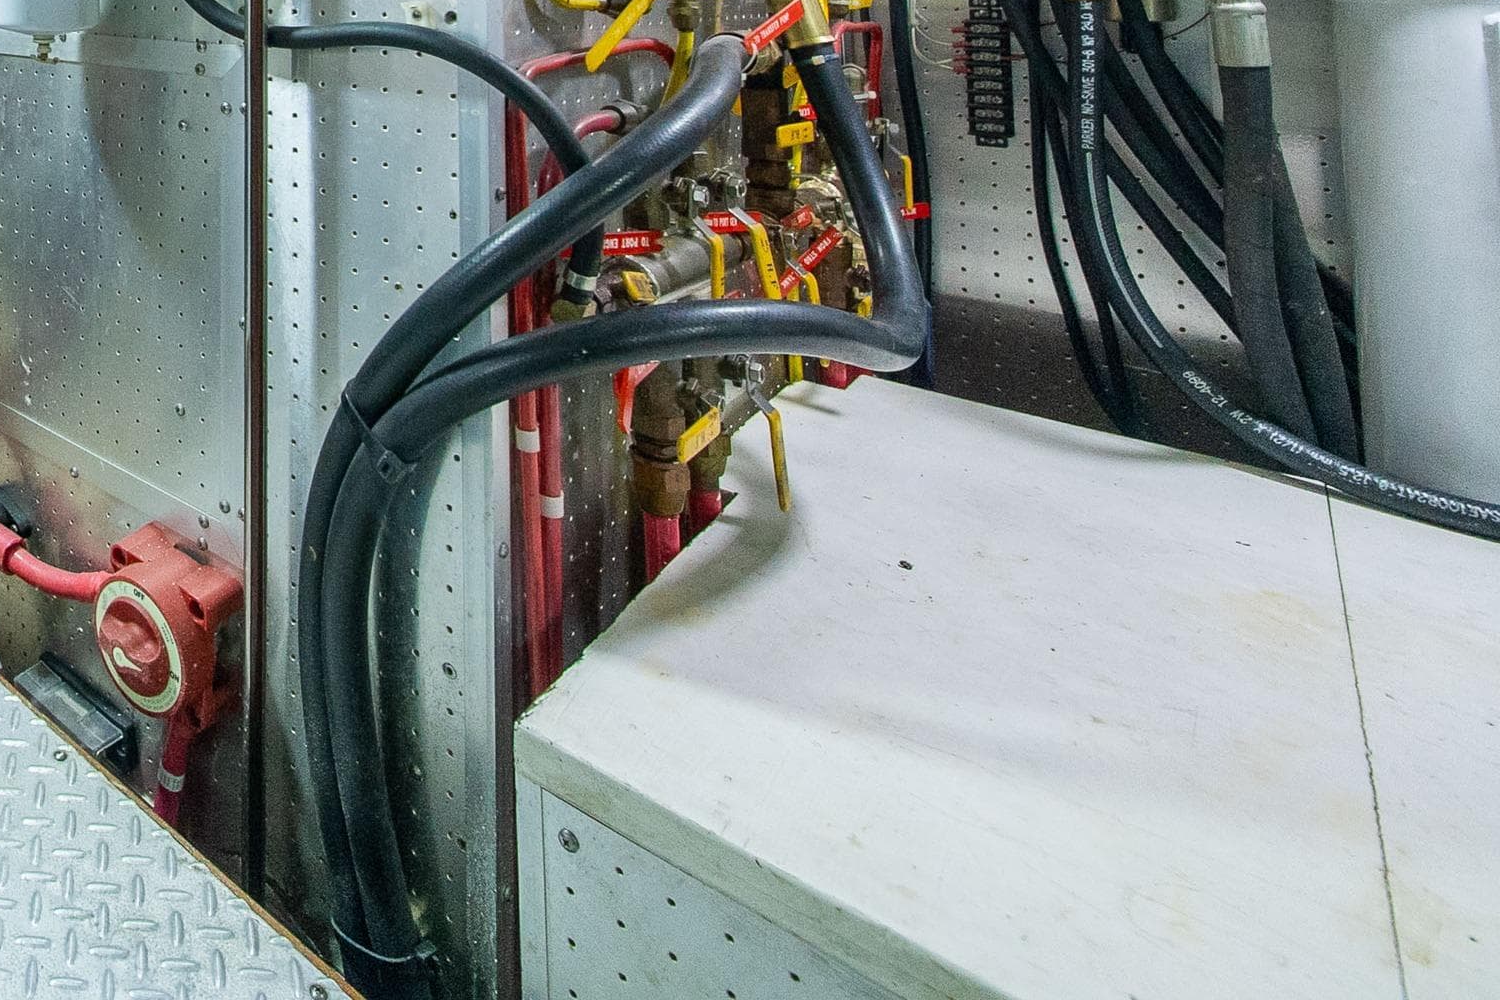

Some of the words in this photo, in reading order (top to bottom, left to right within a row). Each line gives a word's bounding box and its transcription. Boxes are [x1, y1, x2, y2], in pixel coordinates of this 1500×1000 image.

[1080, 49, 1095, 73] 301-8
[1080, 118, 1095, 150] PARKER
[621, 237, 640, 249] PORT
[641, 237, 650, 248] TO
[1229, 408, 1253, 425] 2W
[133, 588, 146, 601] OFF
[169, 670, 180, 684] ON
